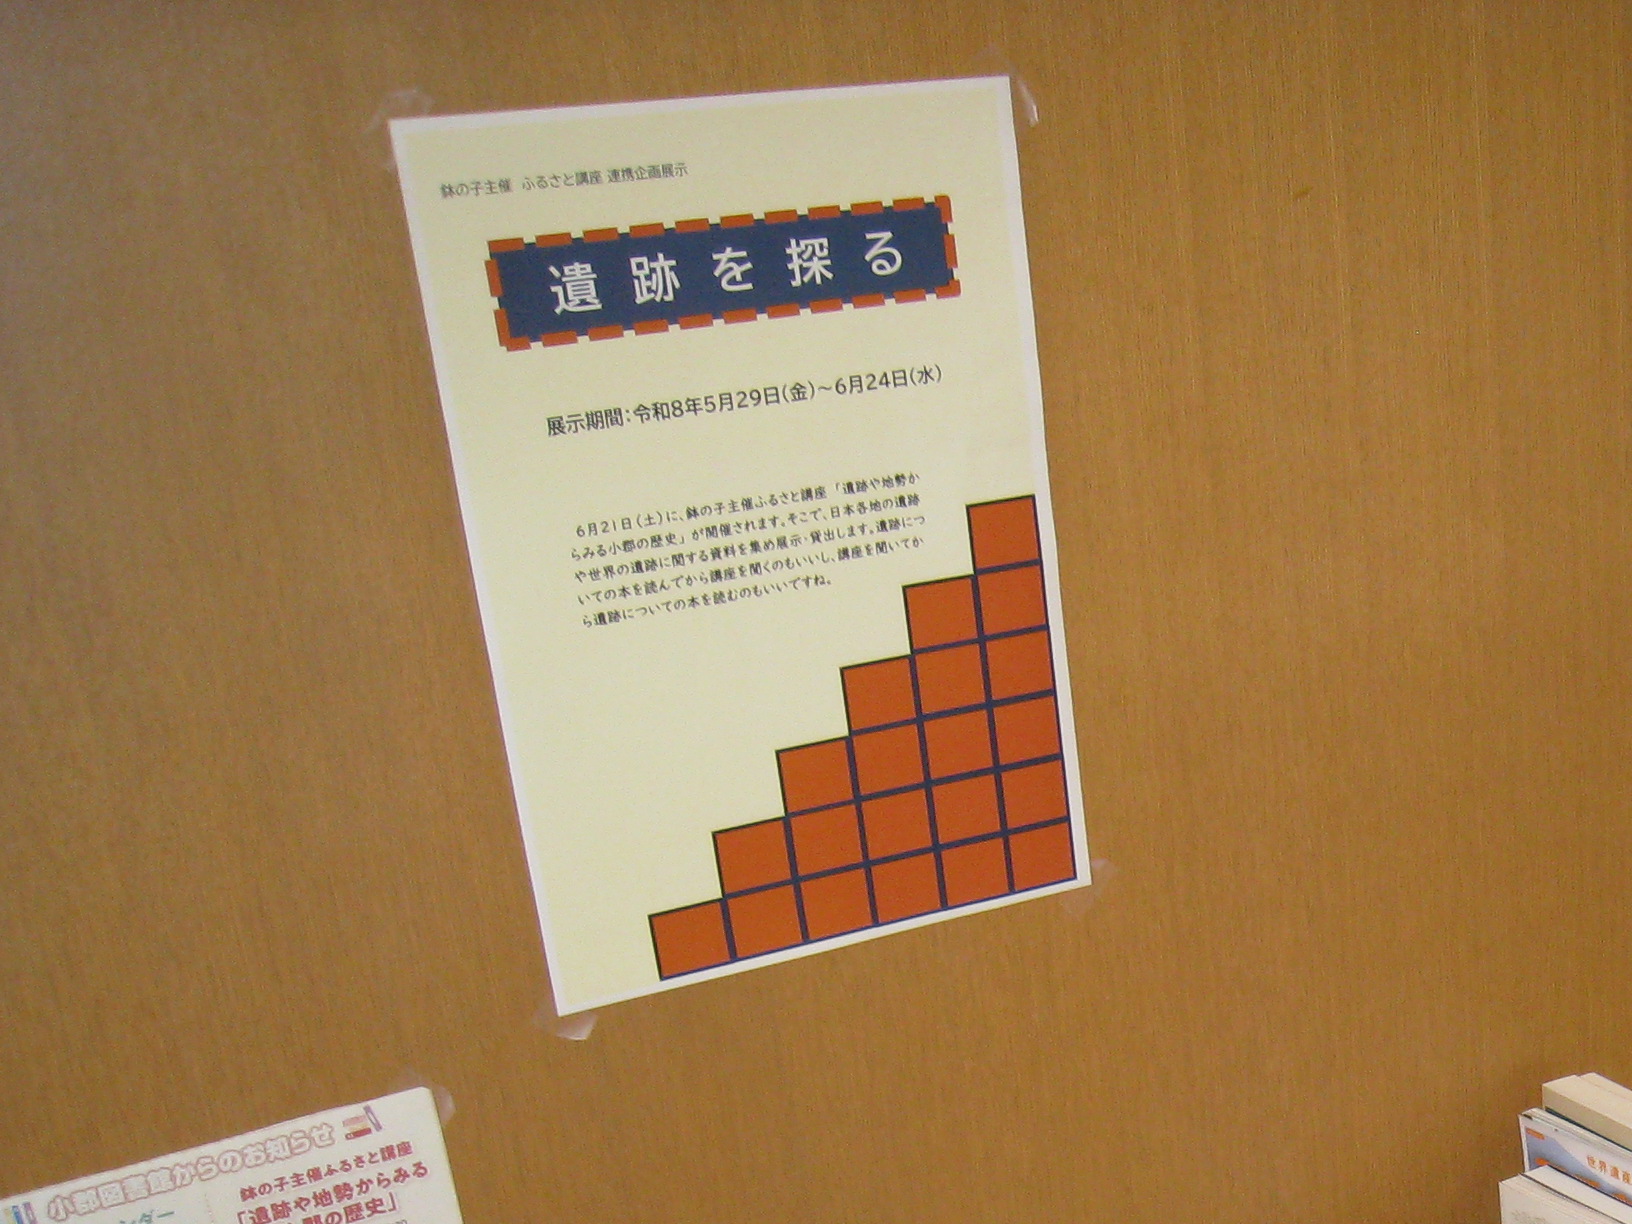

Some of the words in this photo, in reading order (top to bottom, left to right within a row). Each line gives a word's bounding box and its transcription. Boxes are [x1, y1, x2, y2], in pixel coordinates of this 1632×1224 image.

[440, 177, 512, 199] 鉢の子主催
[522, 169, 603, 191] ふるさと講座
[607, 162, 689, 184] 連携企画展示
[547, 229, 905, 315] 遺跡を探る
[47, 1122, 336, 1222] 小郡図書館からのお知らせ
[240, 1140, 413, 1202] 鉢の子主催ふるさと講座
